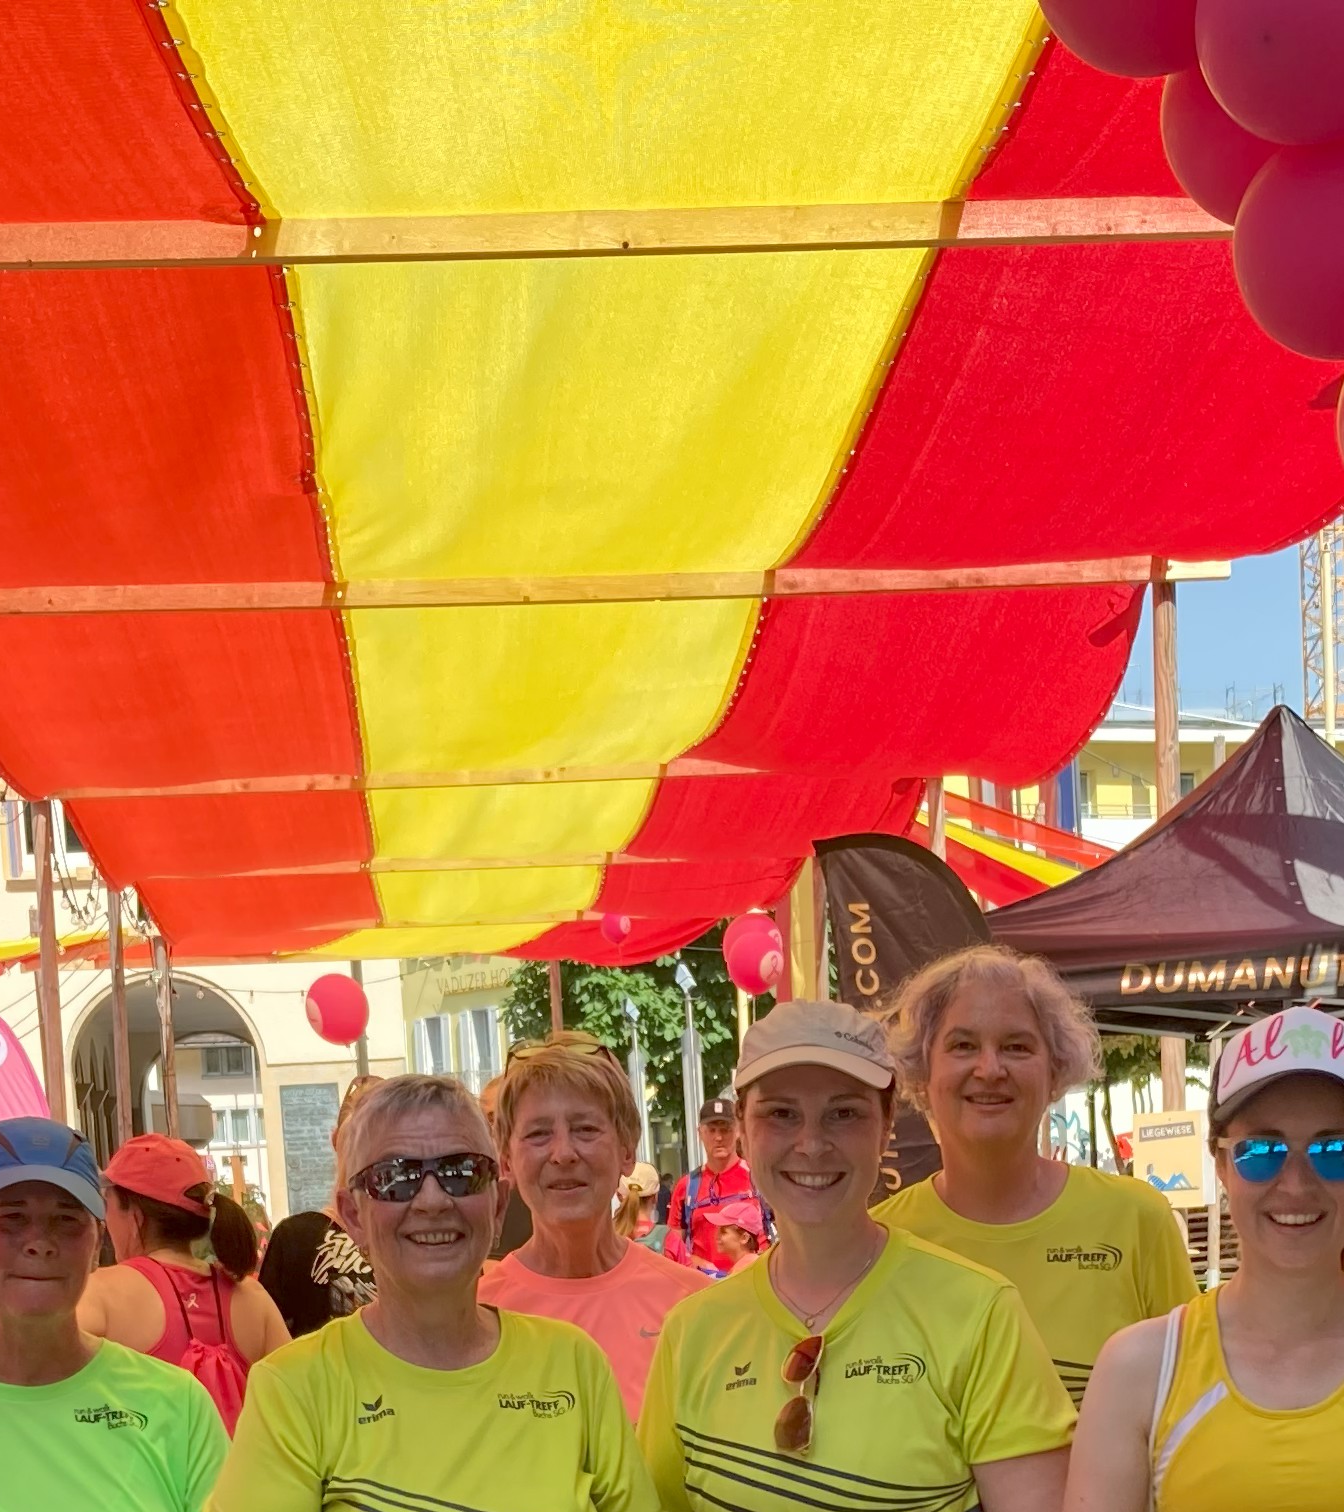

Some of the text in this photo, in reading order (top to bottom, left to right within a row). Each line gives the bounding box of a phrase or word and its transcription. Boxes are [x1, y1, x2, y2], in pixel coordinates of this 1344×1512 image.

[1140, 1124, 1193, 1139] LIEGEWIESE
[1046, 1253, 1108, 1262] LAUF-TREFF
[845, 1364, 911, 1378] LAUF-TREFF
[726, 1377, 757, 1391] erima
[499, 1399, 559, 1411] LAUF-TREFF
[358, 1407, 395, 1425] erima
